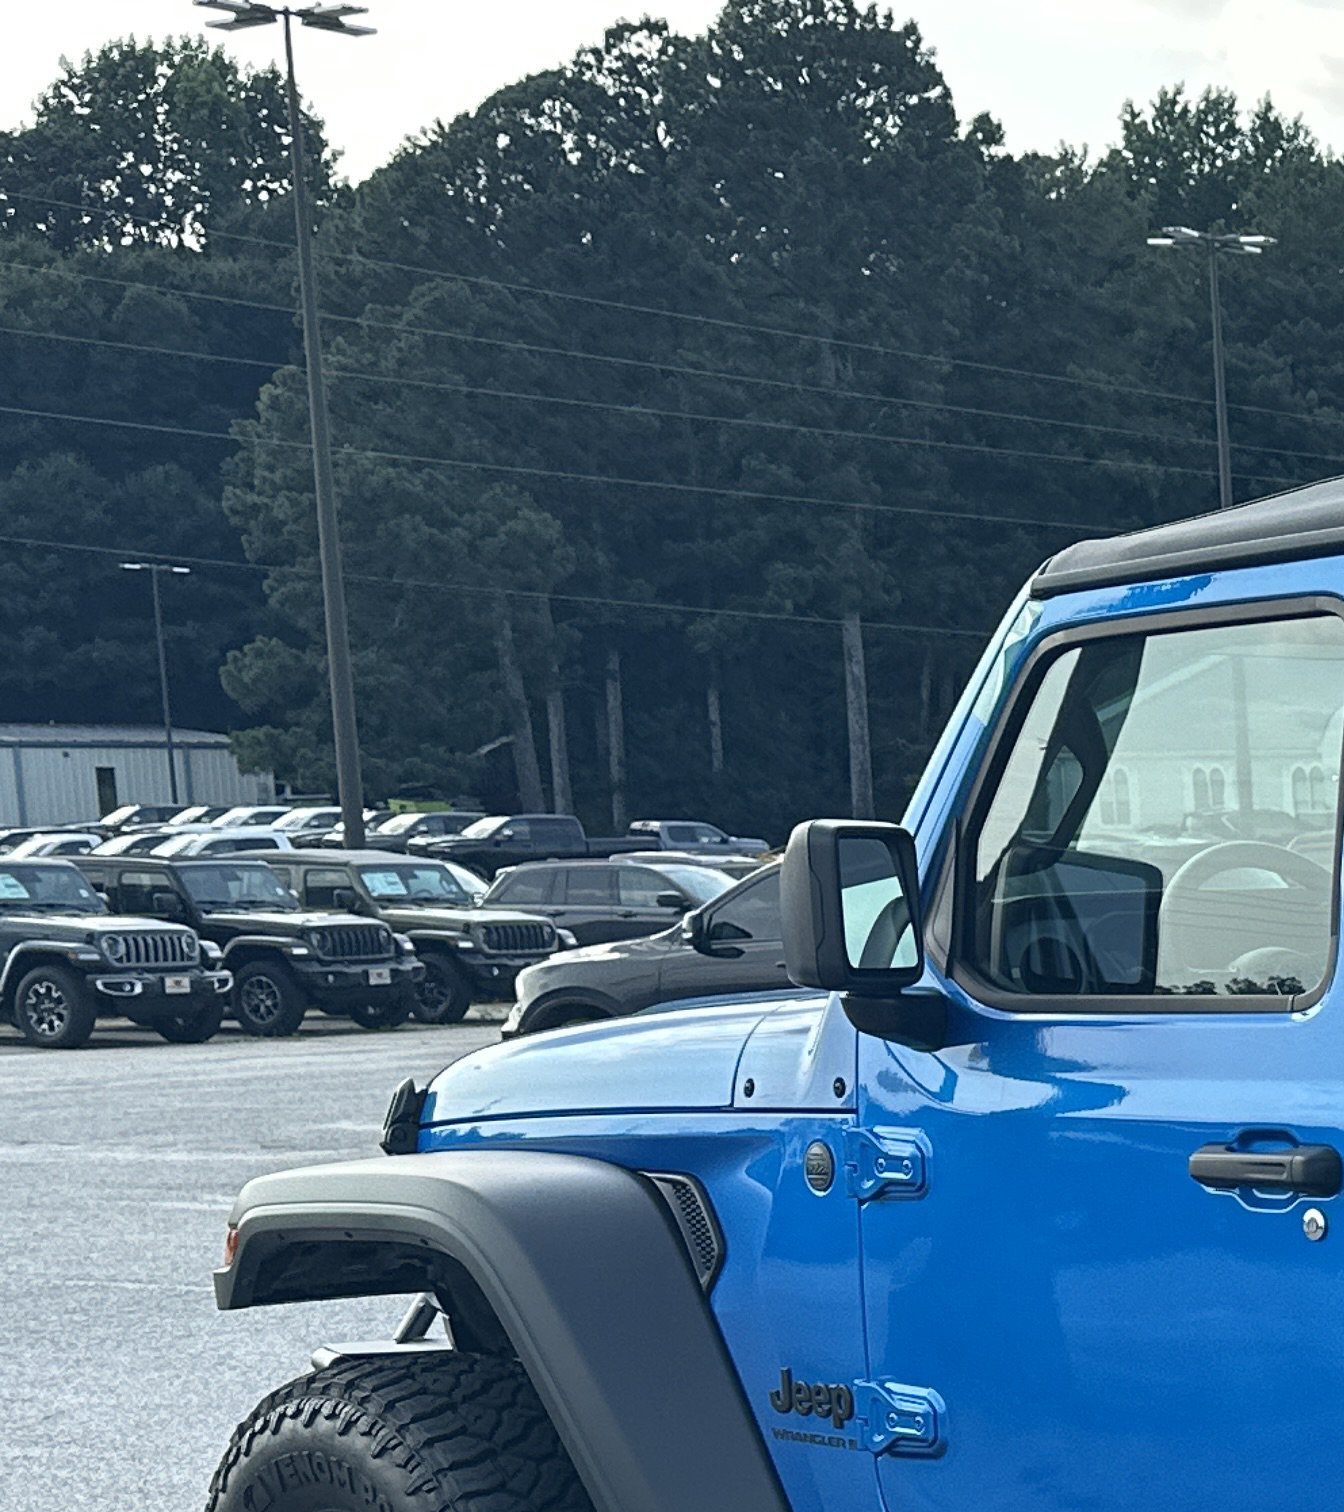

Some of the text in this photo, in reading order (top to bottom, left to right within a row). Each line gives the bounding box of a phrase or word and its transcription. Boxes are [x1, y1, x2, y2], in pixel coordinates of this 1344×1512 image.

[770, 1367, 854, 1427] Jeep
[773, 1429, 846, 1449] WRANGLER
[256, 1451, 356, 1499] VENOM
